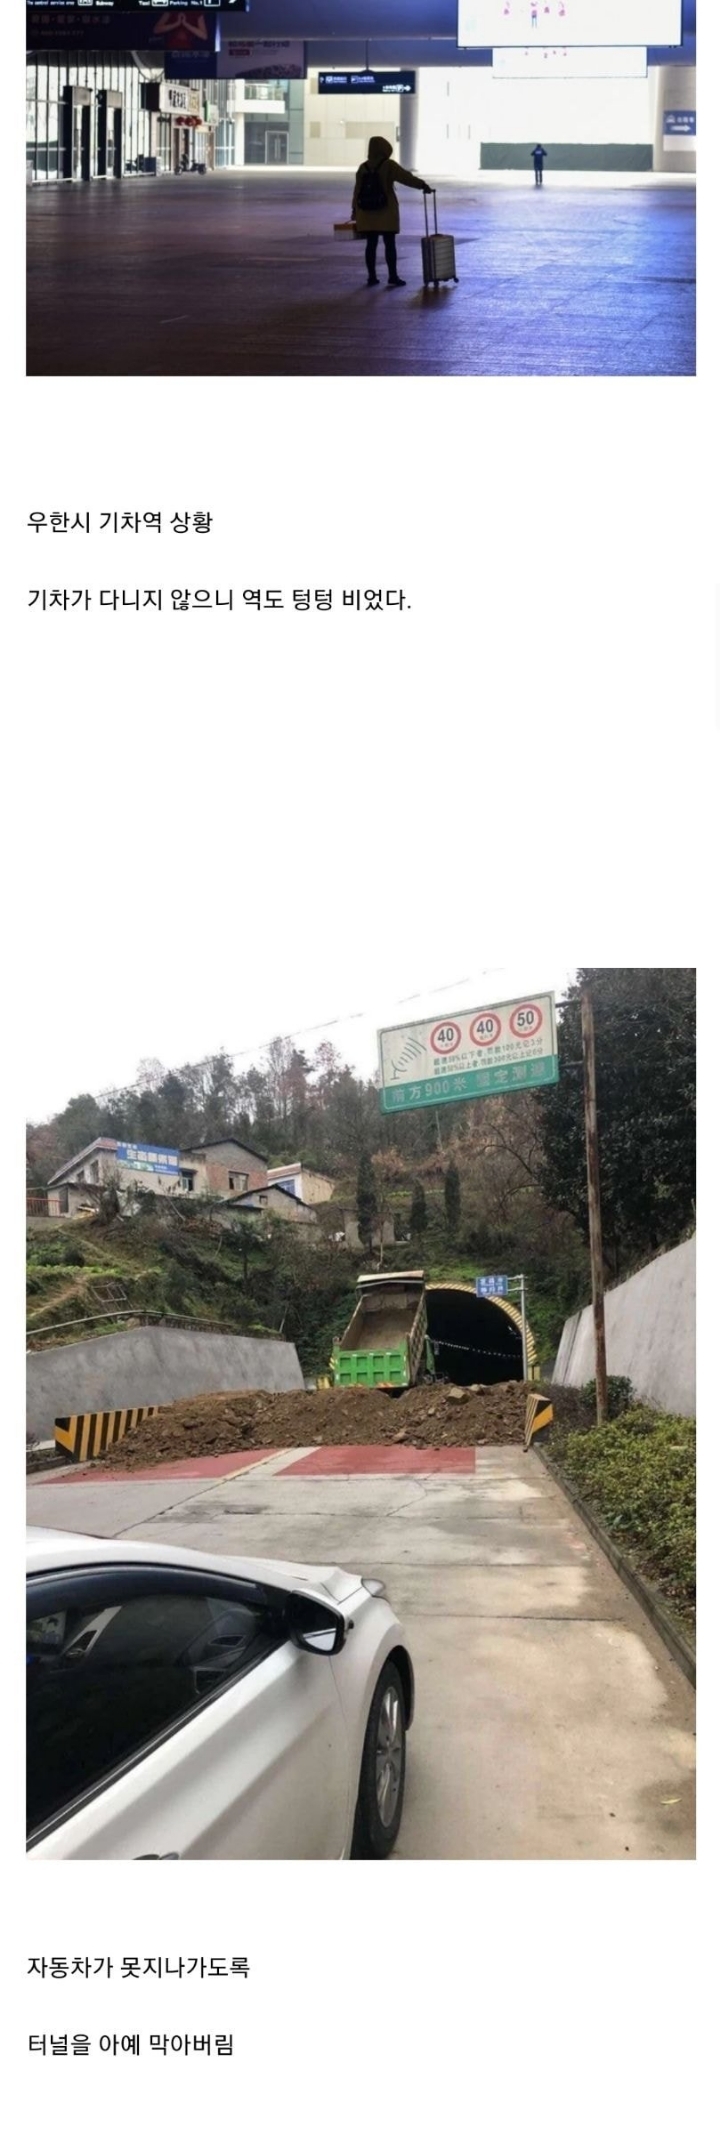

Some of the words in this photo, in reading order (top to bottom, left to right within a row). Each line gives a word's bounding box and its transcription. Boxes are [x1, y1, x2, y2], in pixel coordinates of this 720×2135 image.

[476, 1019, 494, 1034] 40
[516, 1010, 535, 1027] 50
[437, 1028, 454, 1043] 40
[391, 1077, 468, 1102] 前方900米
